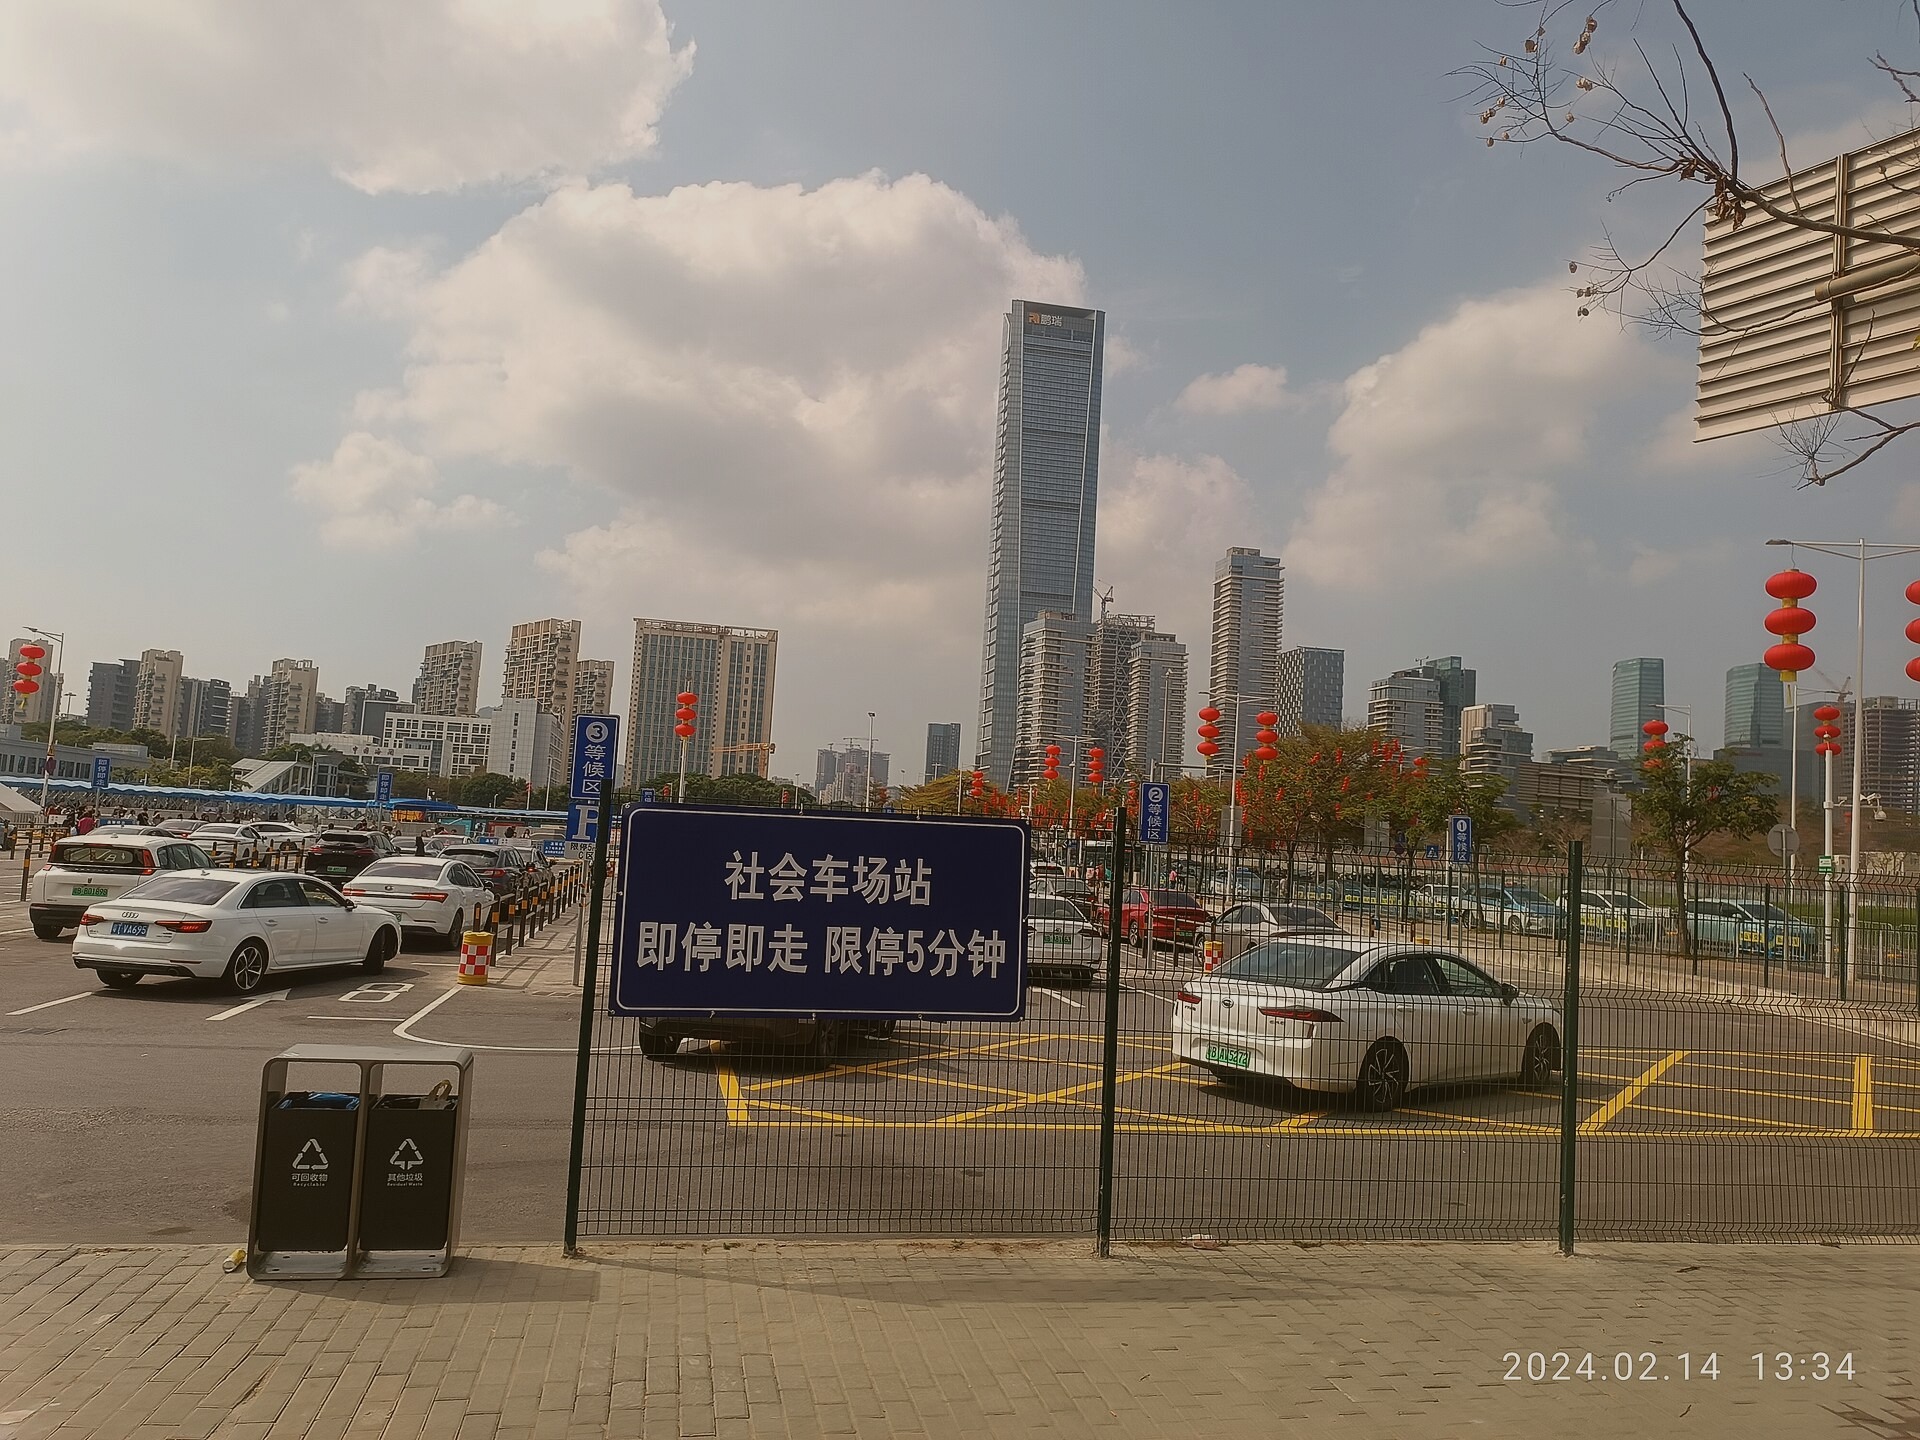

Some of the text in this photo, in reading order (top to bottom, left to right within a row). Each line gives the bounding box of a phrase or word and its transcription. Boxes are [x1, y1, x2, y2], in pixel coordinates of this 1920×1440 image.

[582, 744, 606, 793] 等候区
[1147, 803, 1162, 840] 等候区
[724, 850, 932, 906] 社会车场站
[636, 921, 1006, 979] 即停即走 限停5分钟
[291, 1172, 328, 1182] 可回收物
[387, 1172, 423, 1182] 其他垃圾
